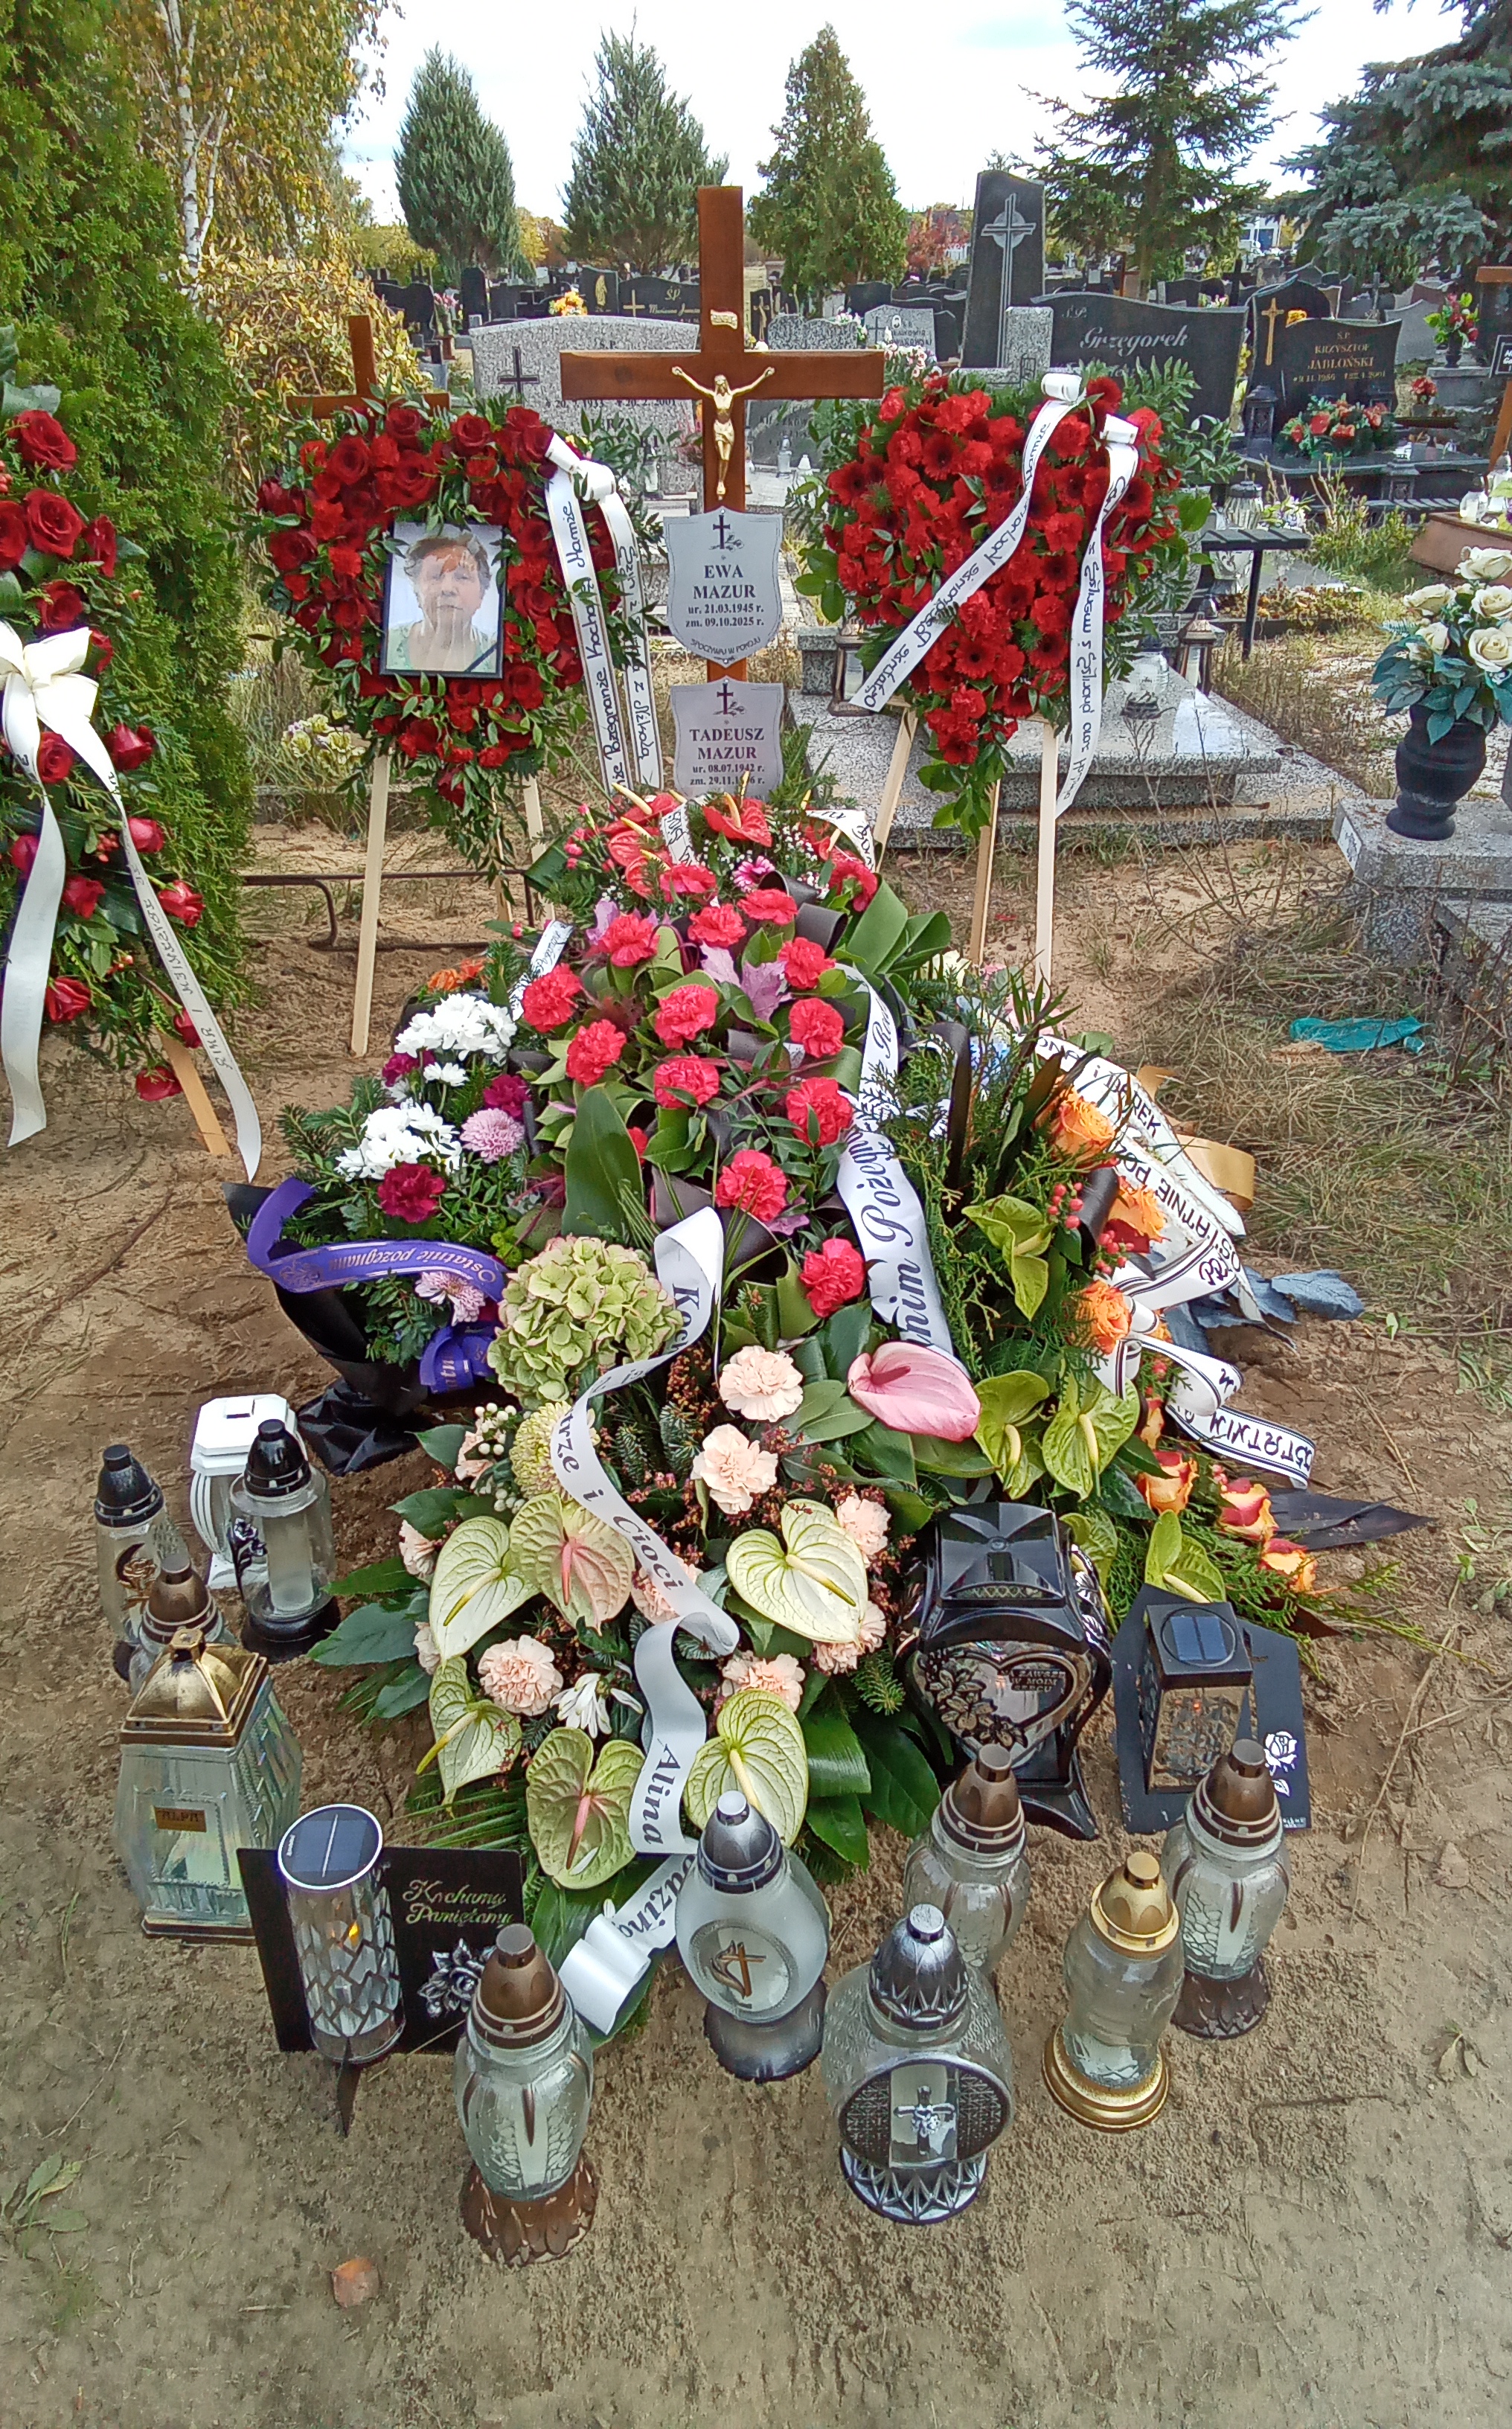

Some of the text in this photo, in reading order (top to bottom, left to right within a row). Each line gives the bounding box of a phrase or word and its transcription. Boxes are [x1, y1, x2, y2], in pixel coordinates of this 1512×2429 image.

[704, 564, 743, 579] EWA
[693, 584, 756, 599] MAZUR
[688, 604, 764, 614] ur. 21.03.1945 r.
[705, 617, 754, 627] 09.10.2025
[689, 728, 765, 742] TADEUSZ
[697, 746, 757, 760] MAZUR
[692, 764, 765, 773] ur. 08.07.1942 r.
[708, 776, 756, 785] 29.11.16
[420, 1249, 498, 1283] Ostatnie
[612, 1514, 685, 1591] Cioci
[644, 1738, 682, 1846] Alina
[402, 1879, 507, 1910] Kochamy
